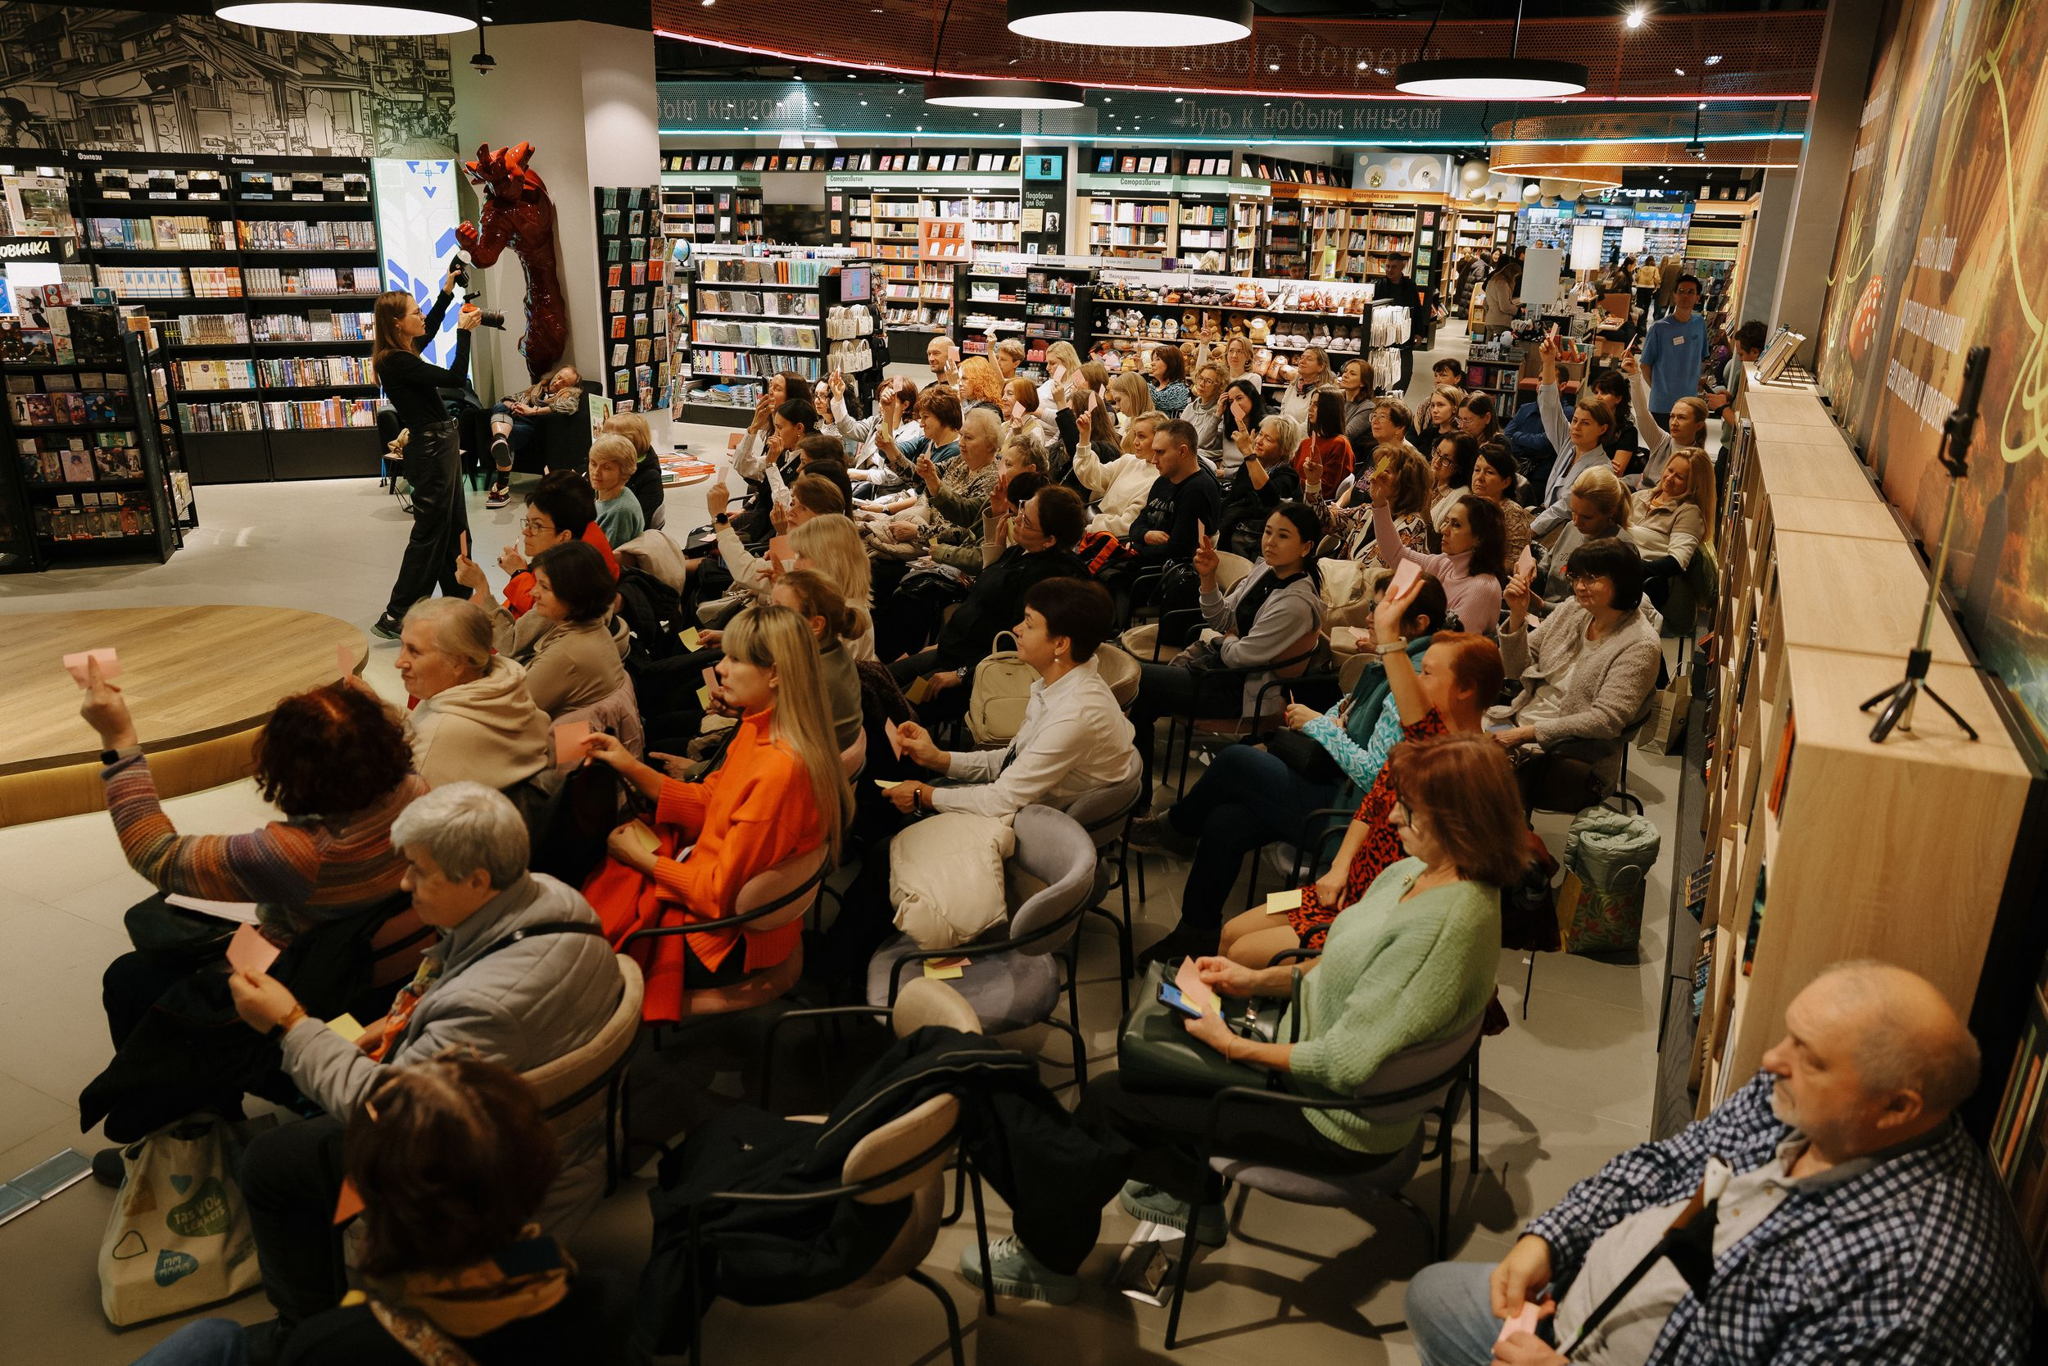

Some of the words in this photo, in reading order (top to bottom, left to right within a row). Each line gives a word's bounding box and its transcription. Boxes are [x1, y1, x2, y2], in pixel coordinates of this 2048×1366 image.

[1180, 100, 1232, 135] Путь
[1243, 108, 1254, 130] к
[1263, 101, 1343, 130] новым
[1353, 107, 1442, 130] книгам
[0, 240, 51, 259] ОВИНКА
